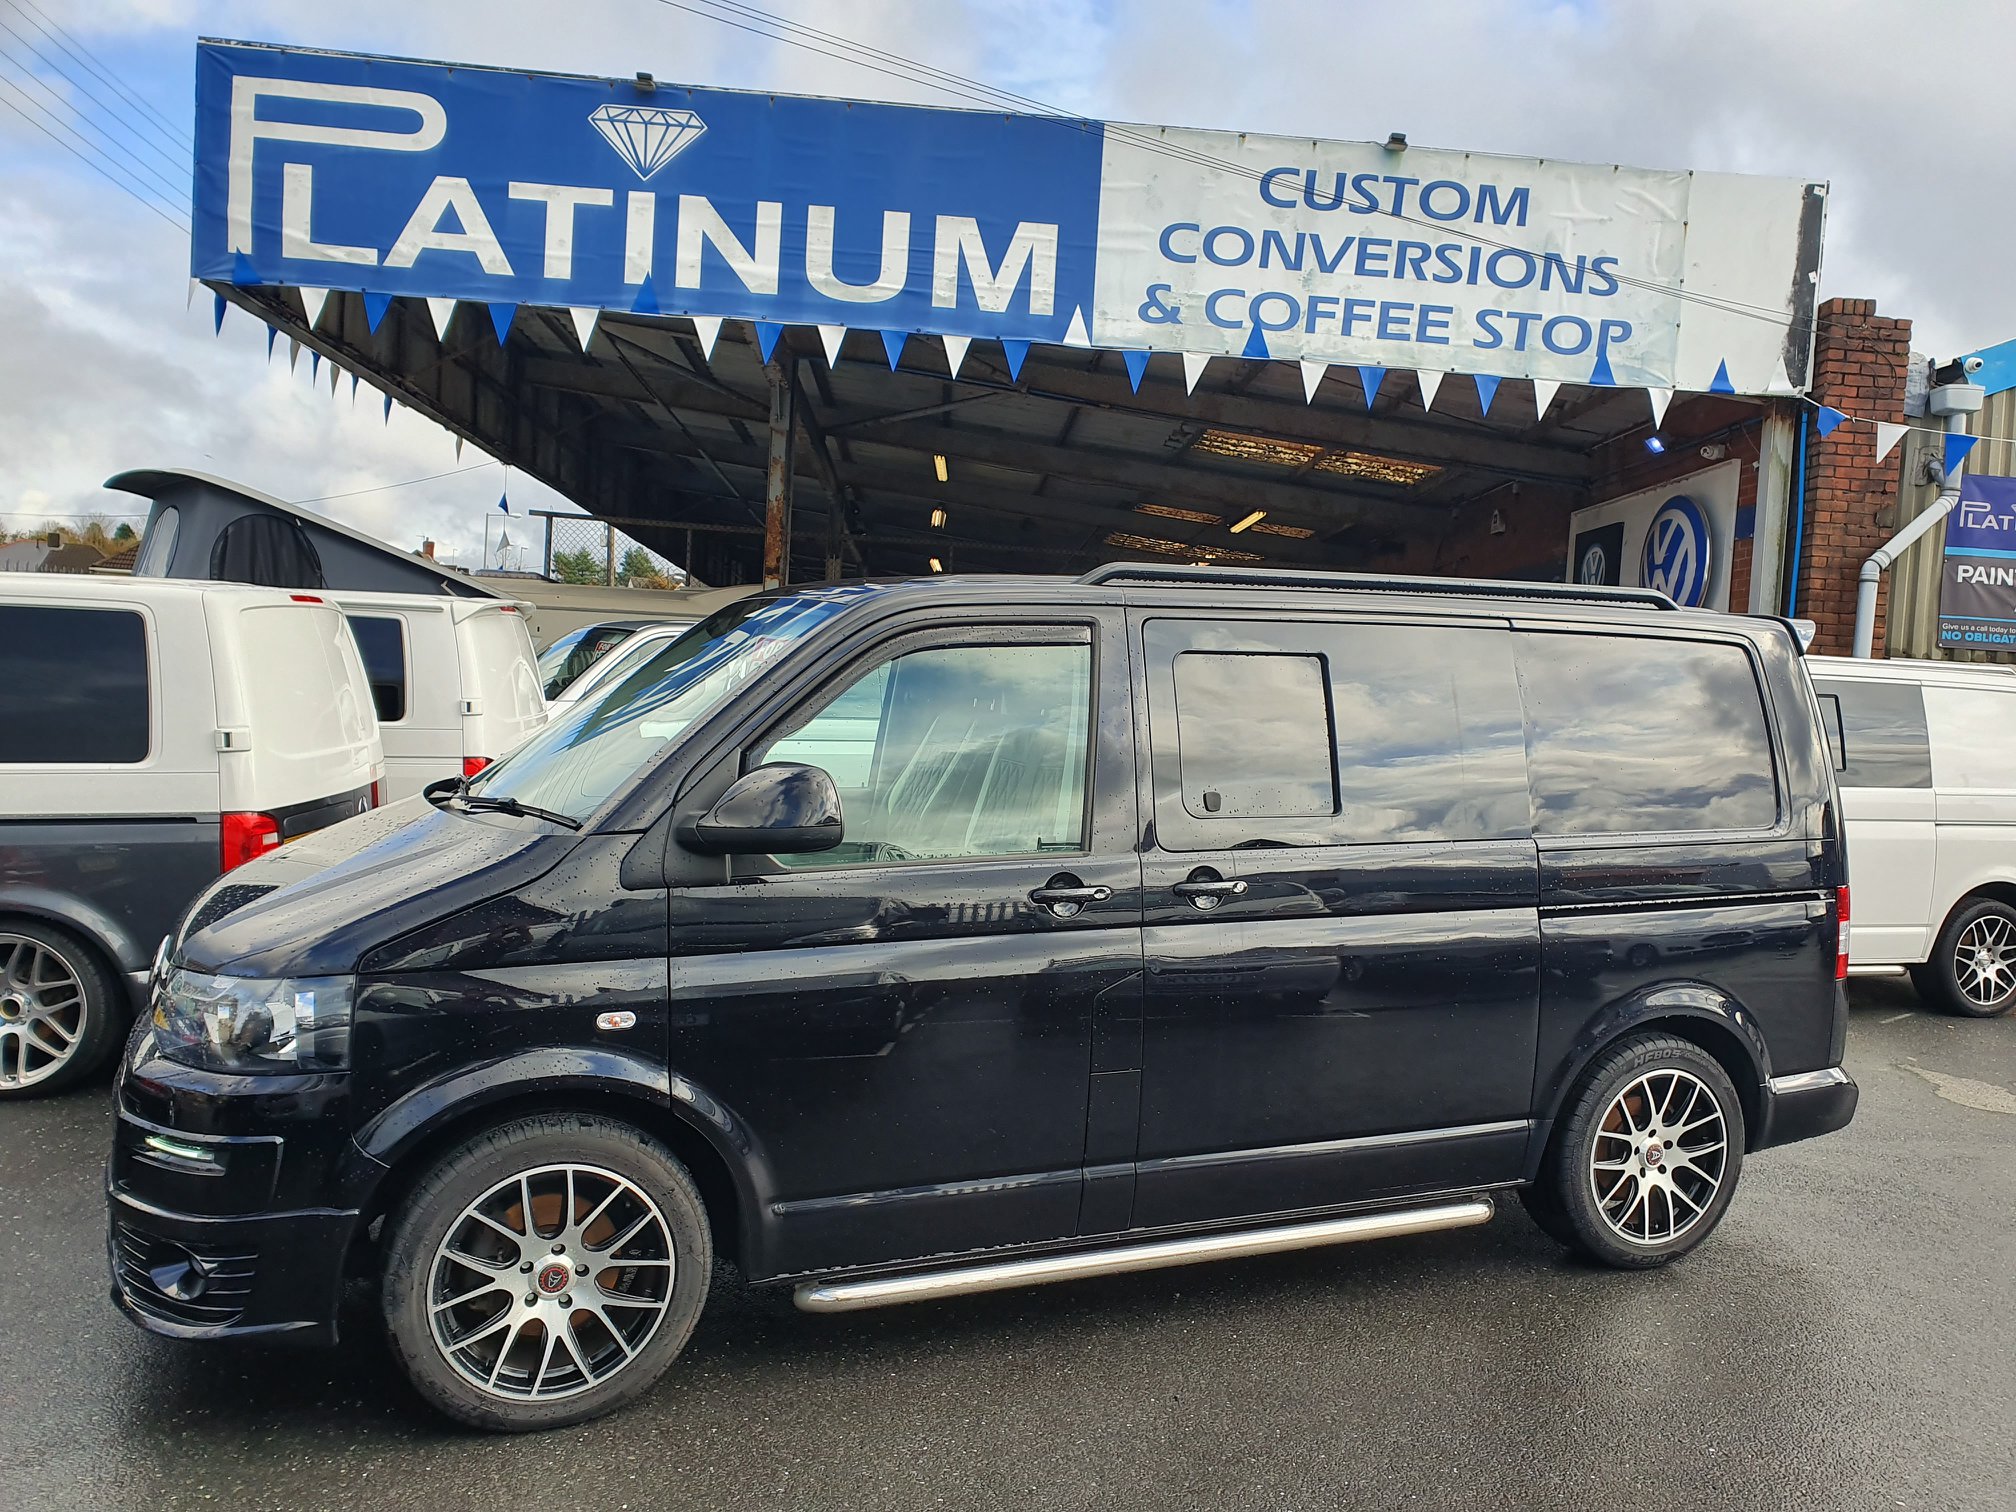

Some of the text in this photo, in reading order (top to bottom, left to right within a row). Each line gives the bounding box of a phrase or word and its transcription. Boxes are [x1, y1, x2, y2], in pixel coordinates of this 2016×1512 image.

[227, 74, 1059, 316] PLATINUM
[1259, 166, 1529, 226] CUSTOM
[1158, 222, 1620, 296] CONVERSIONS
[1137, 283, 1634, 356] & COFFEE STOP
[1957, 564, 2016, 587] PAIN
[1941, 630, 1962, 641] NO
[1942, 622, 1959, 630] Give
[1989, 626, 2009, 635] today
